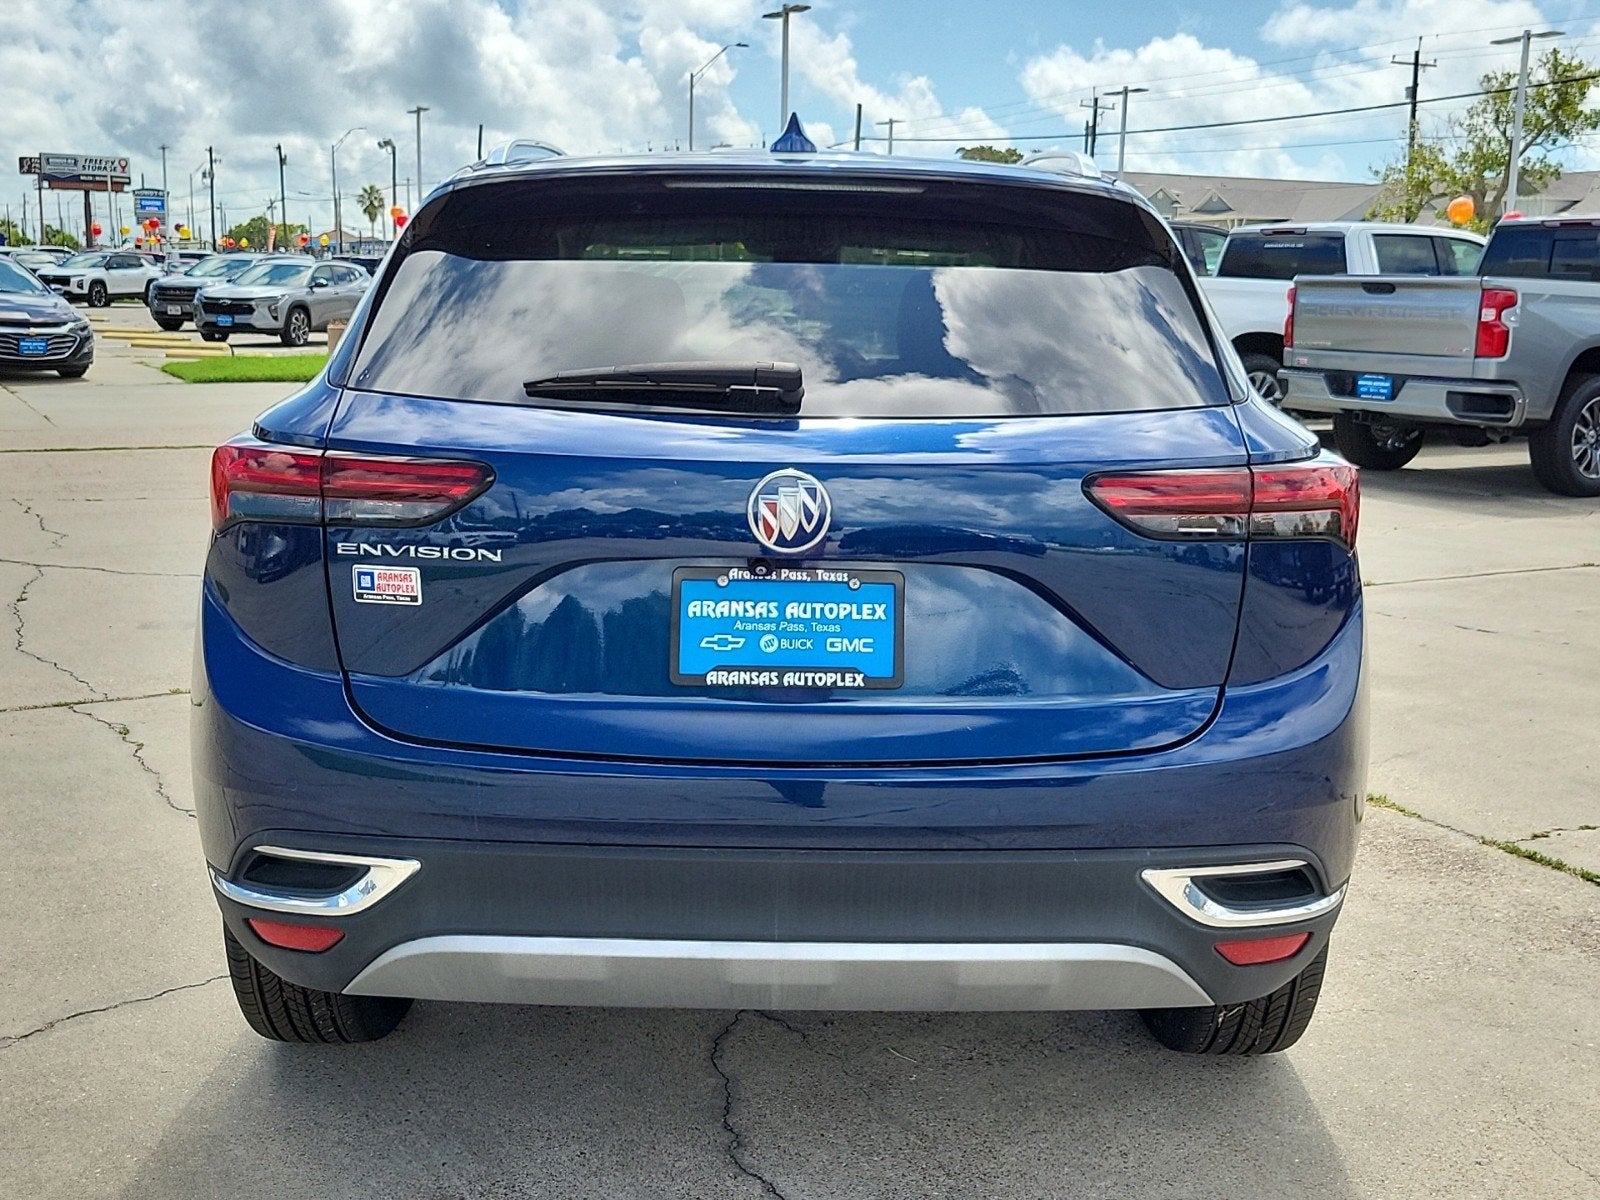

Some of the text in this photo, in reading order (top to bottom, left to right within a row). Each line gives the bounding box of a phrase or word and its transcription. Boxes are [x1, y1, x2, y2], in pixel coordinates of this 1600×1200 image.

[337, 542, 502, 562] ENVISION
[377, 572, 413, 583] ARANSAS
[728, 567, 849, 582] Aras Pass, Texas
[375, 583, 416, 594] AUTOPLEX
[687, 600, 887, 620] ARANSAS AUTOPLEX
[733, 619, 841, 633] Aransas Pass, Texas
[780, 637, 874, 653] BUICK GMC
[706, 670, 865, 687] ARANSAS AUTOPLEX
